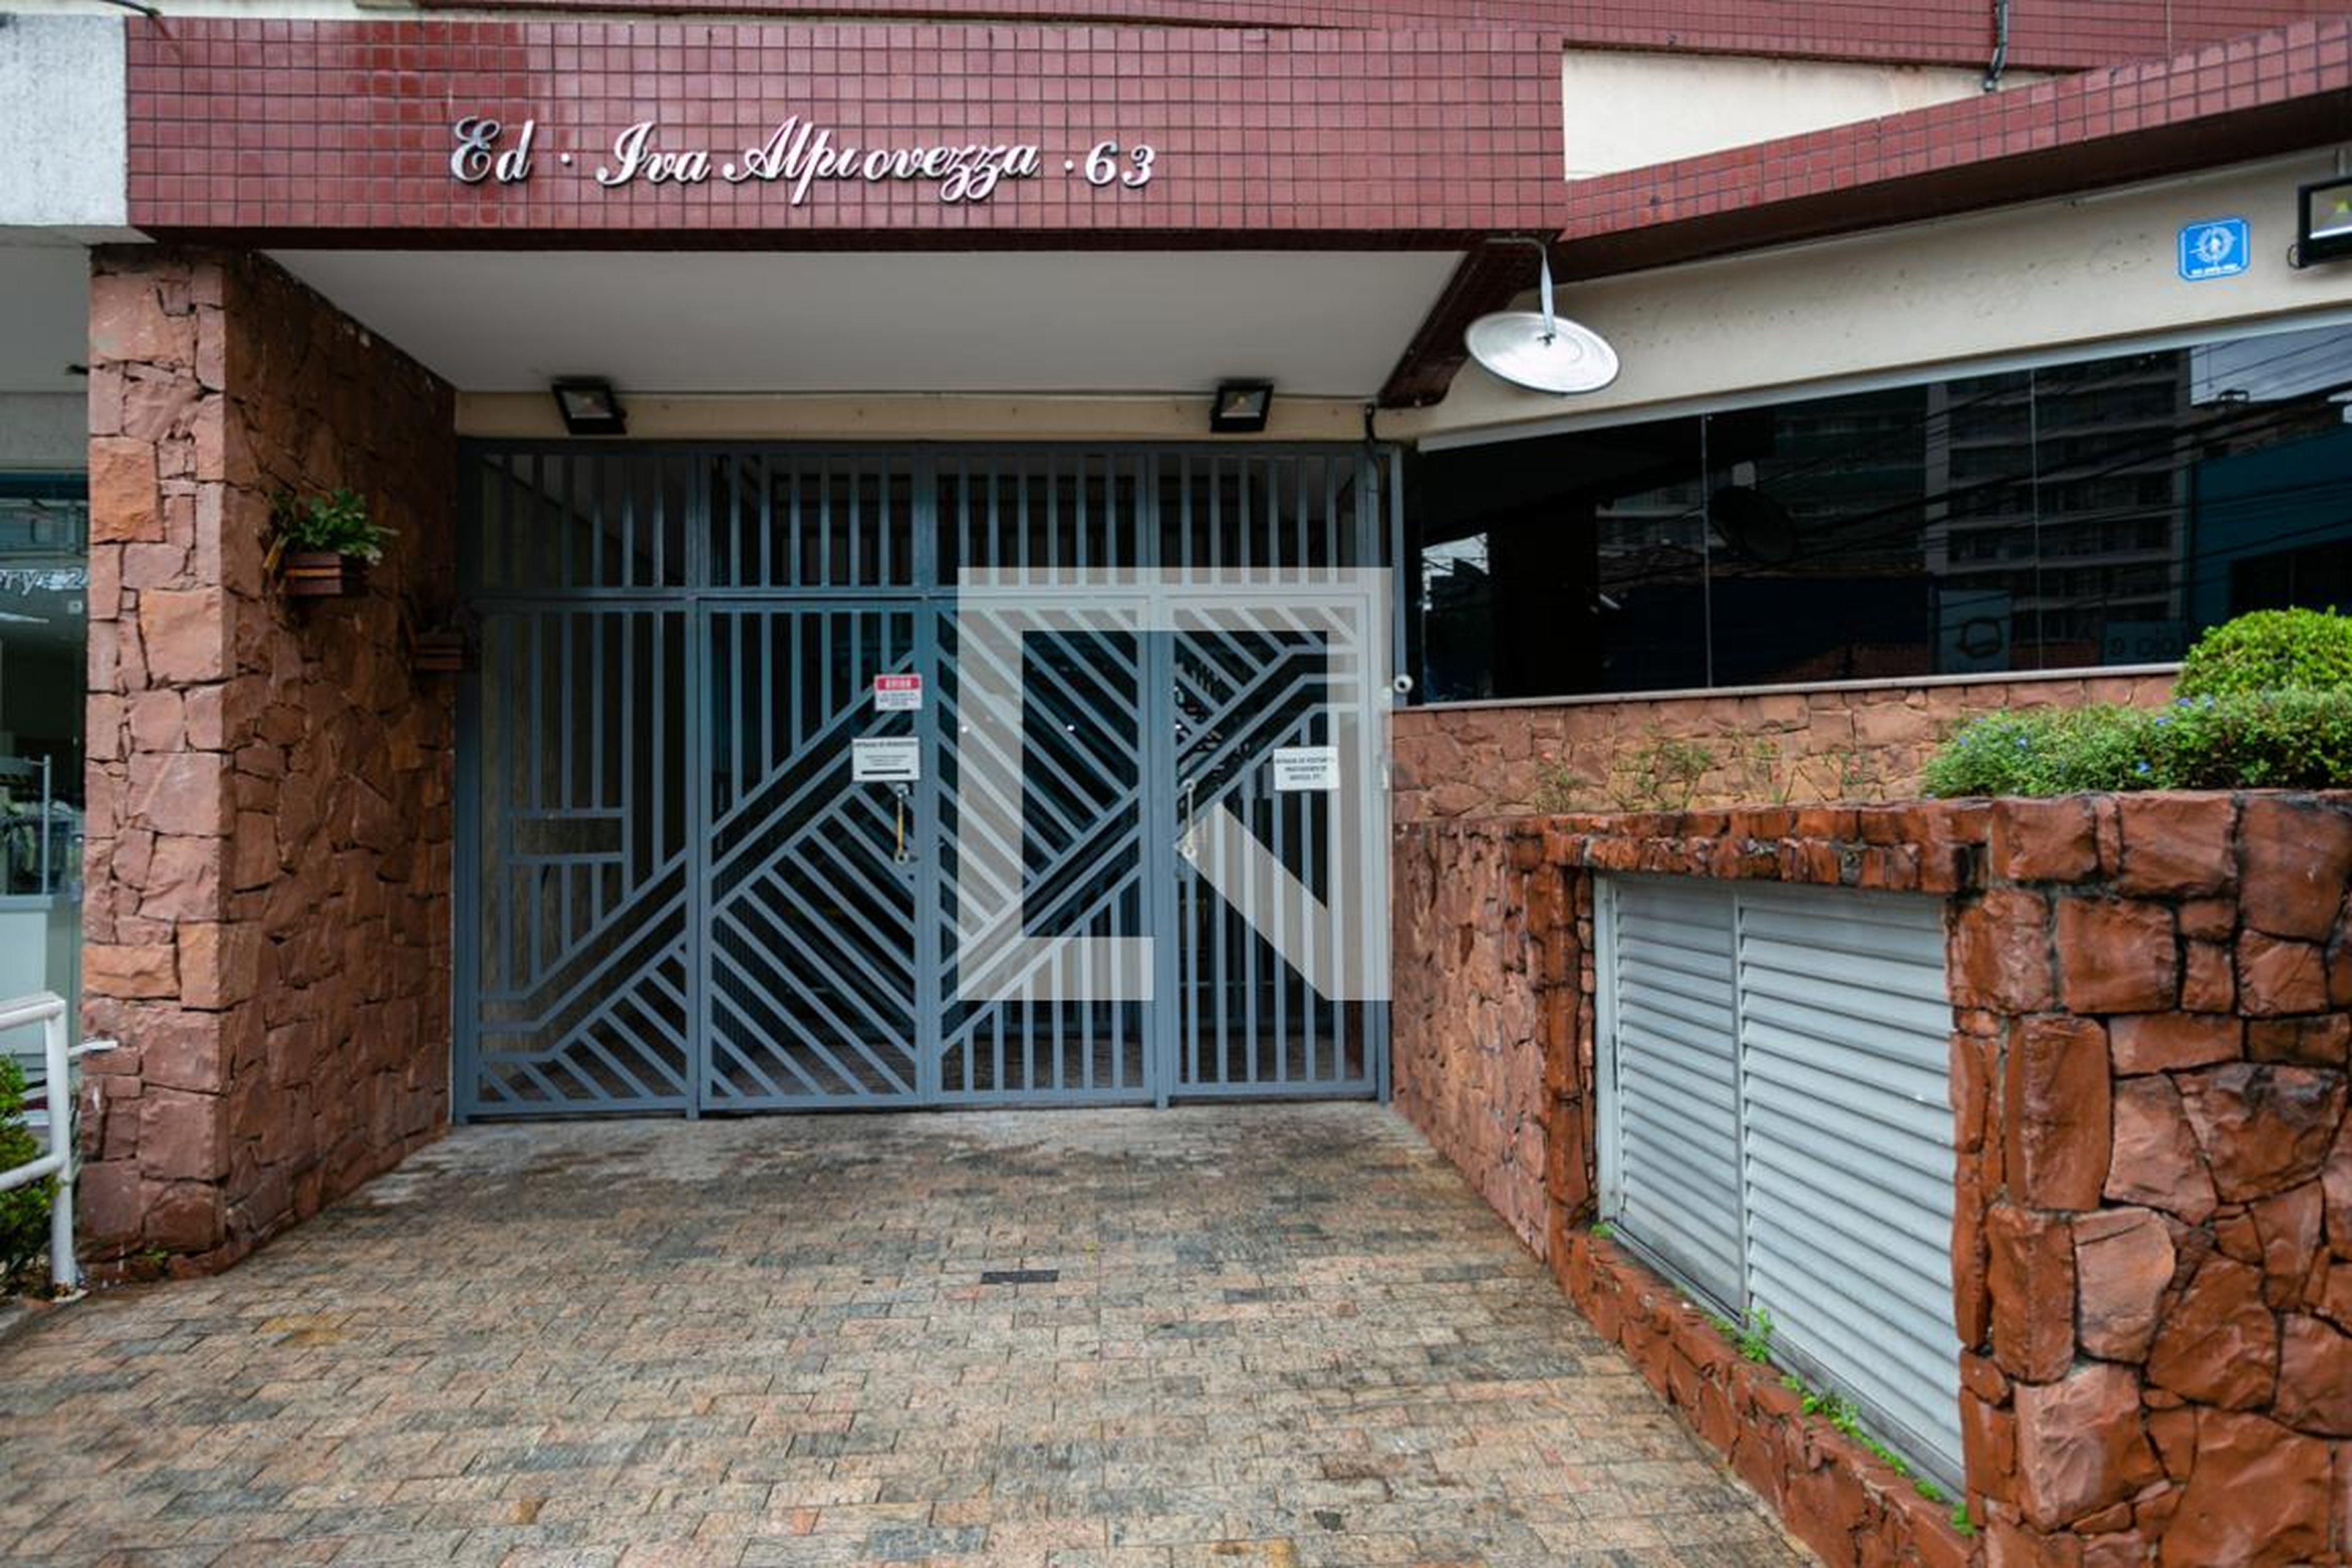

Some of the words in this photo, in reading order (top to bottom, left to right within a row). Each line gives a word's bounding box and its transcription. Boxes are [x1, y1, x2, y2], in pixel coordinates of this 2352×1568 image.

[451, 116, 534, 182] Ed
[596, 122, 711, 186] Iva
[1085, 141, 1155, 187] 63
